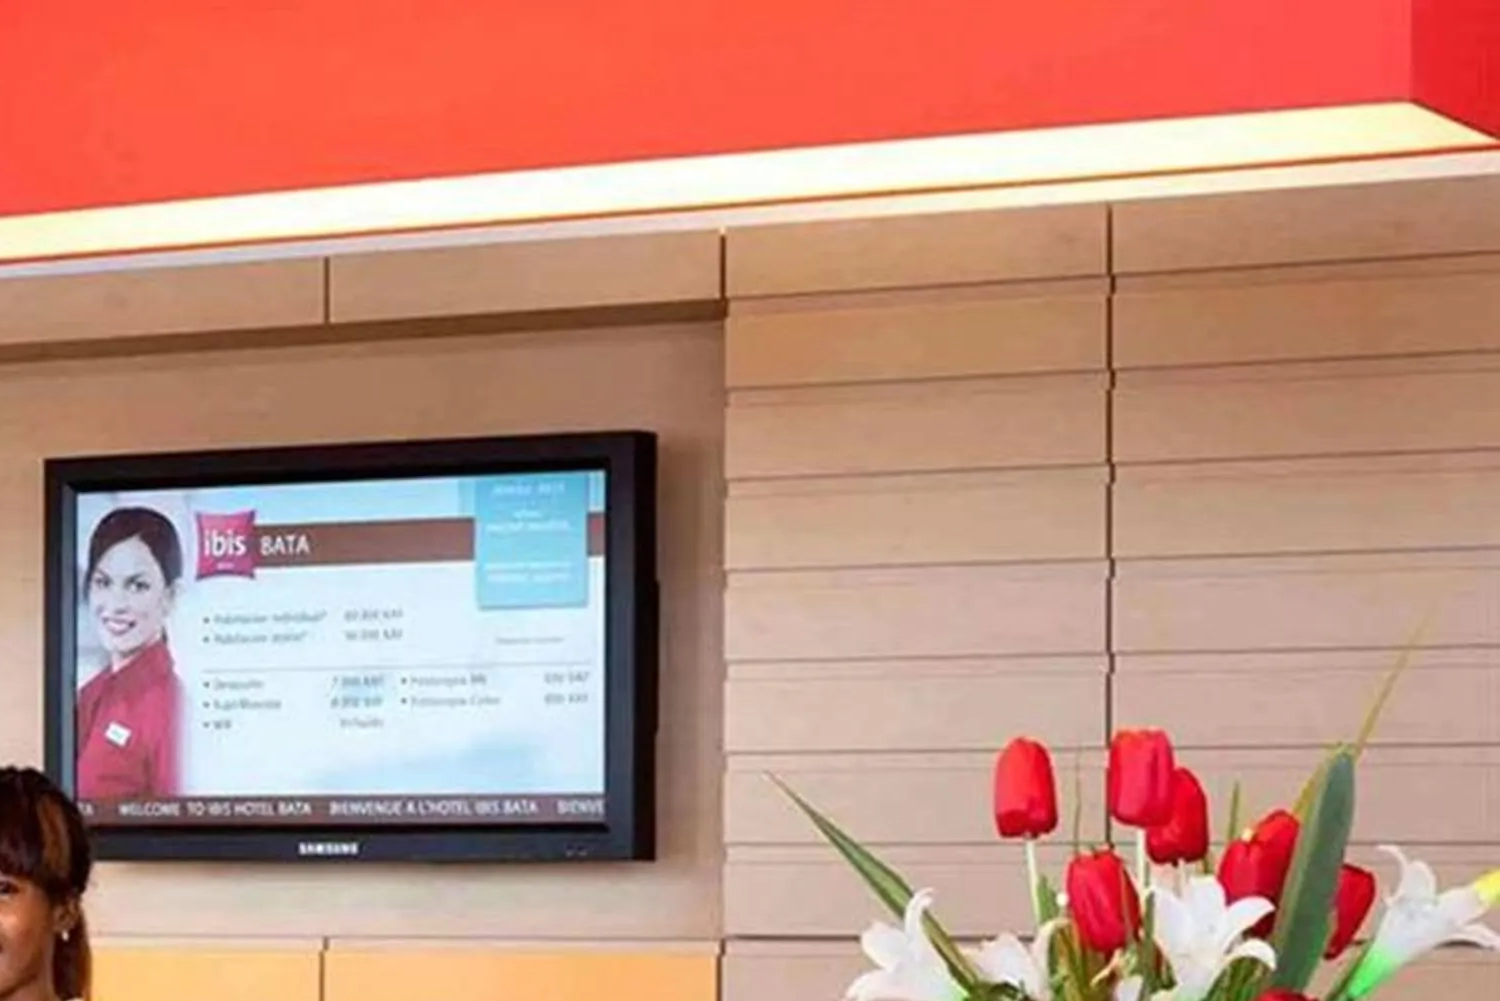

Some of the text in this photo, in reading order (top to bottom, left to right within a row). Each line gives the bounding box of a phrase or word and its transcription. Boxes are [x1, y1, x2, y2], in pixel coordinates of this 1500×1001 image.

[203, 529, 247, 557] ibis
[260, 534, 311, 556] BATA
[119, 800, 312, 817] WELCOME TO IBIS HOTEL BATA
[475, 799, 500, 816] IBIS
[503, 798, 539, 815] BATA
[299, 842, 359, 857] SAMSUNG
